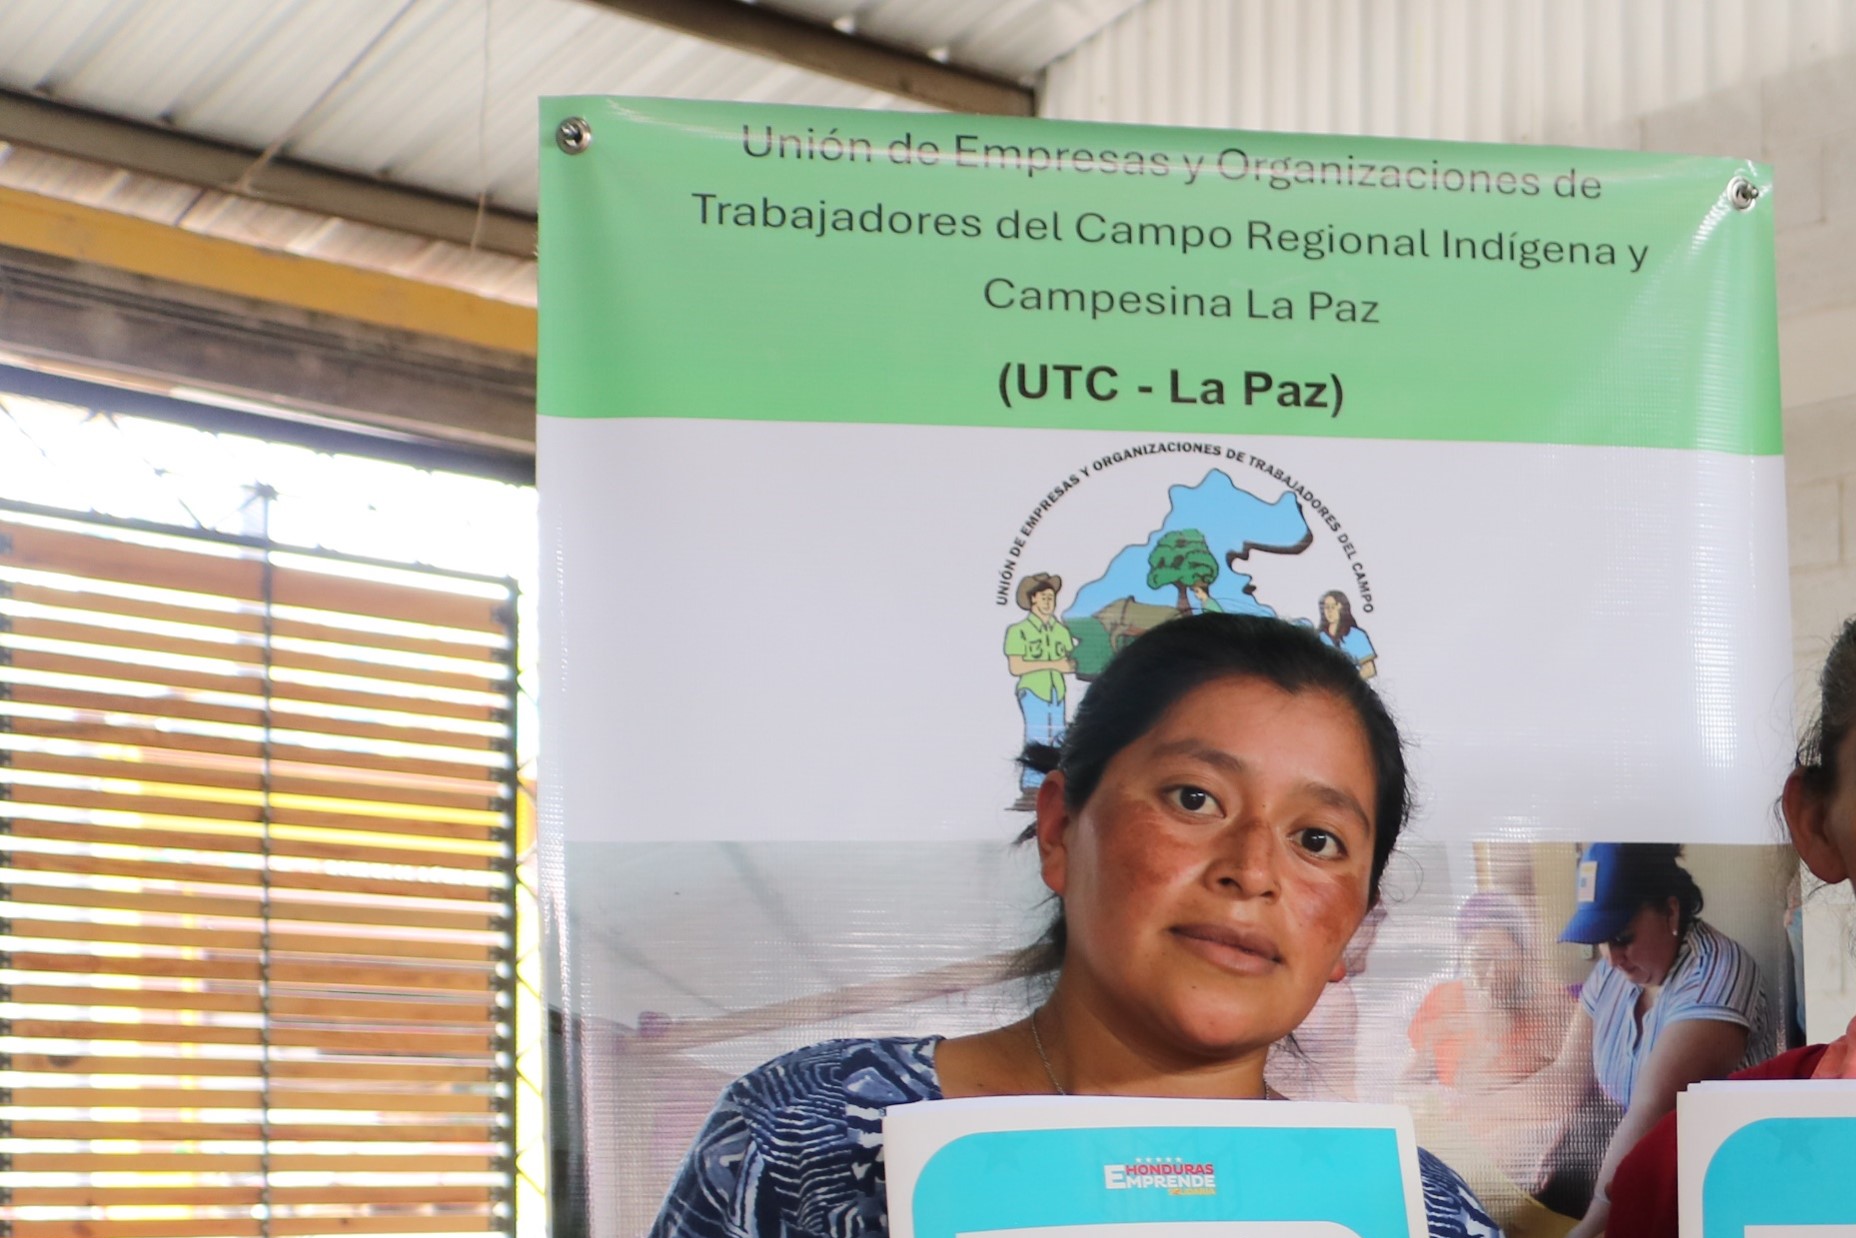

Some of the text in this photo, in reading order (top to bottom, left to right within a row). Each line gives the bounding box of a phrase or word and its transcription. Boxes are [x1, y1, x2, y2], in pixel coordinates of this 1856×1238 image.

[741, 124, 1602, 200] Unión de Empresas y Organizaciones de
[692, 192, 1649, 273] Trabajadores del Campo Regional Indígena y
[984, 277, 1380, 324] Campesina La Paz
[999, 362, 1119, 408] (UTC
[1169, 368, 1225, 407] La
[1243, 370, 1344, 418] Paz)
[996, 442, 1374, 614] UNIÓN DE EMPRESAS Y ORGANIZACIONES DE TRABAJADORES DEL CAMPO
[1104, 1164, 1216, 1189] EMPRENDE
[1125, 1164, 1214, 1176] HONDURAS
